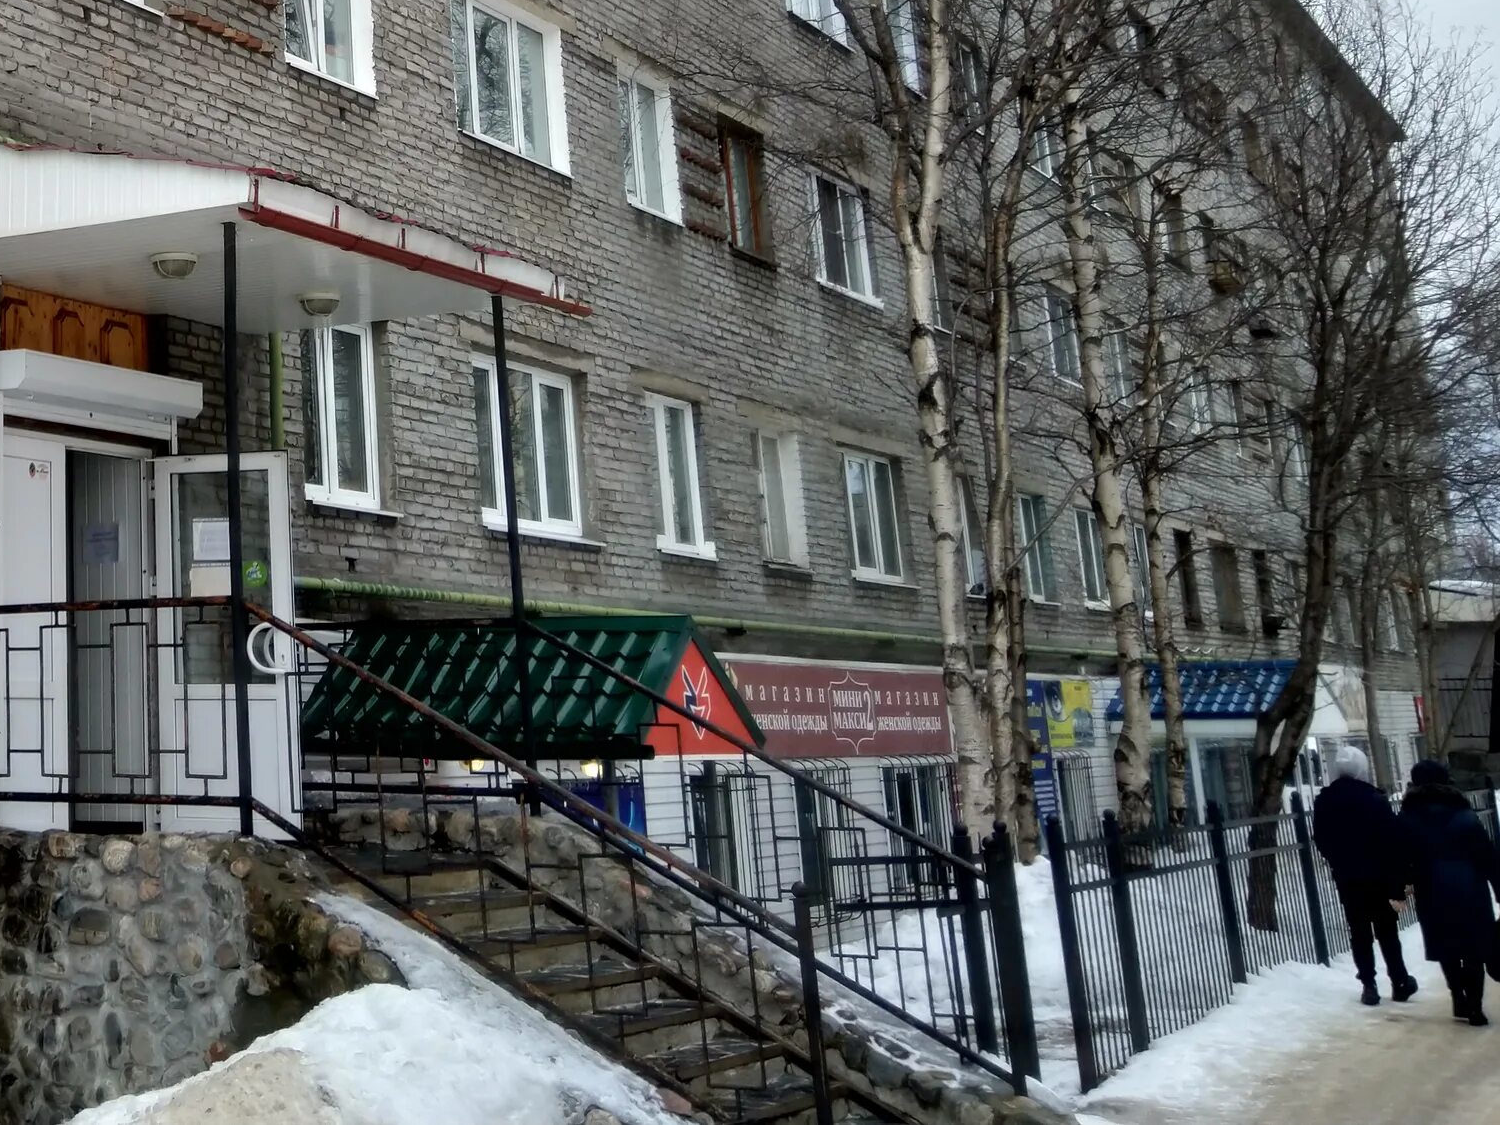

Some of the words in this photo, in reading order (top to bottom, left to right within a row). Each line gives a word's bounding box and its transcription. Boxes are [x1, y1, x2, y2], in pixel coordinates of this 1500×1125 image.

[745, 684, 825, 703] магазин
[832, 690, 863, 707] МИНИ
[874, 690, 939, 706] магазин
[863, 690, 874, 730] 2
[791, 715, 828, 734] одежды
[832, 712, 867, 730] МАКСИ
[876, 711, 913, 731] женской
[912, 717, 942, 734] одежды
